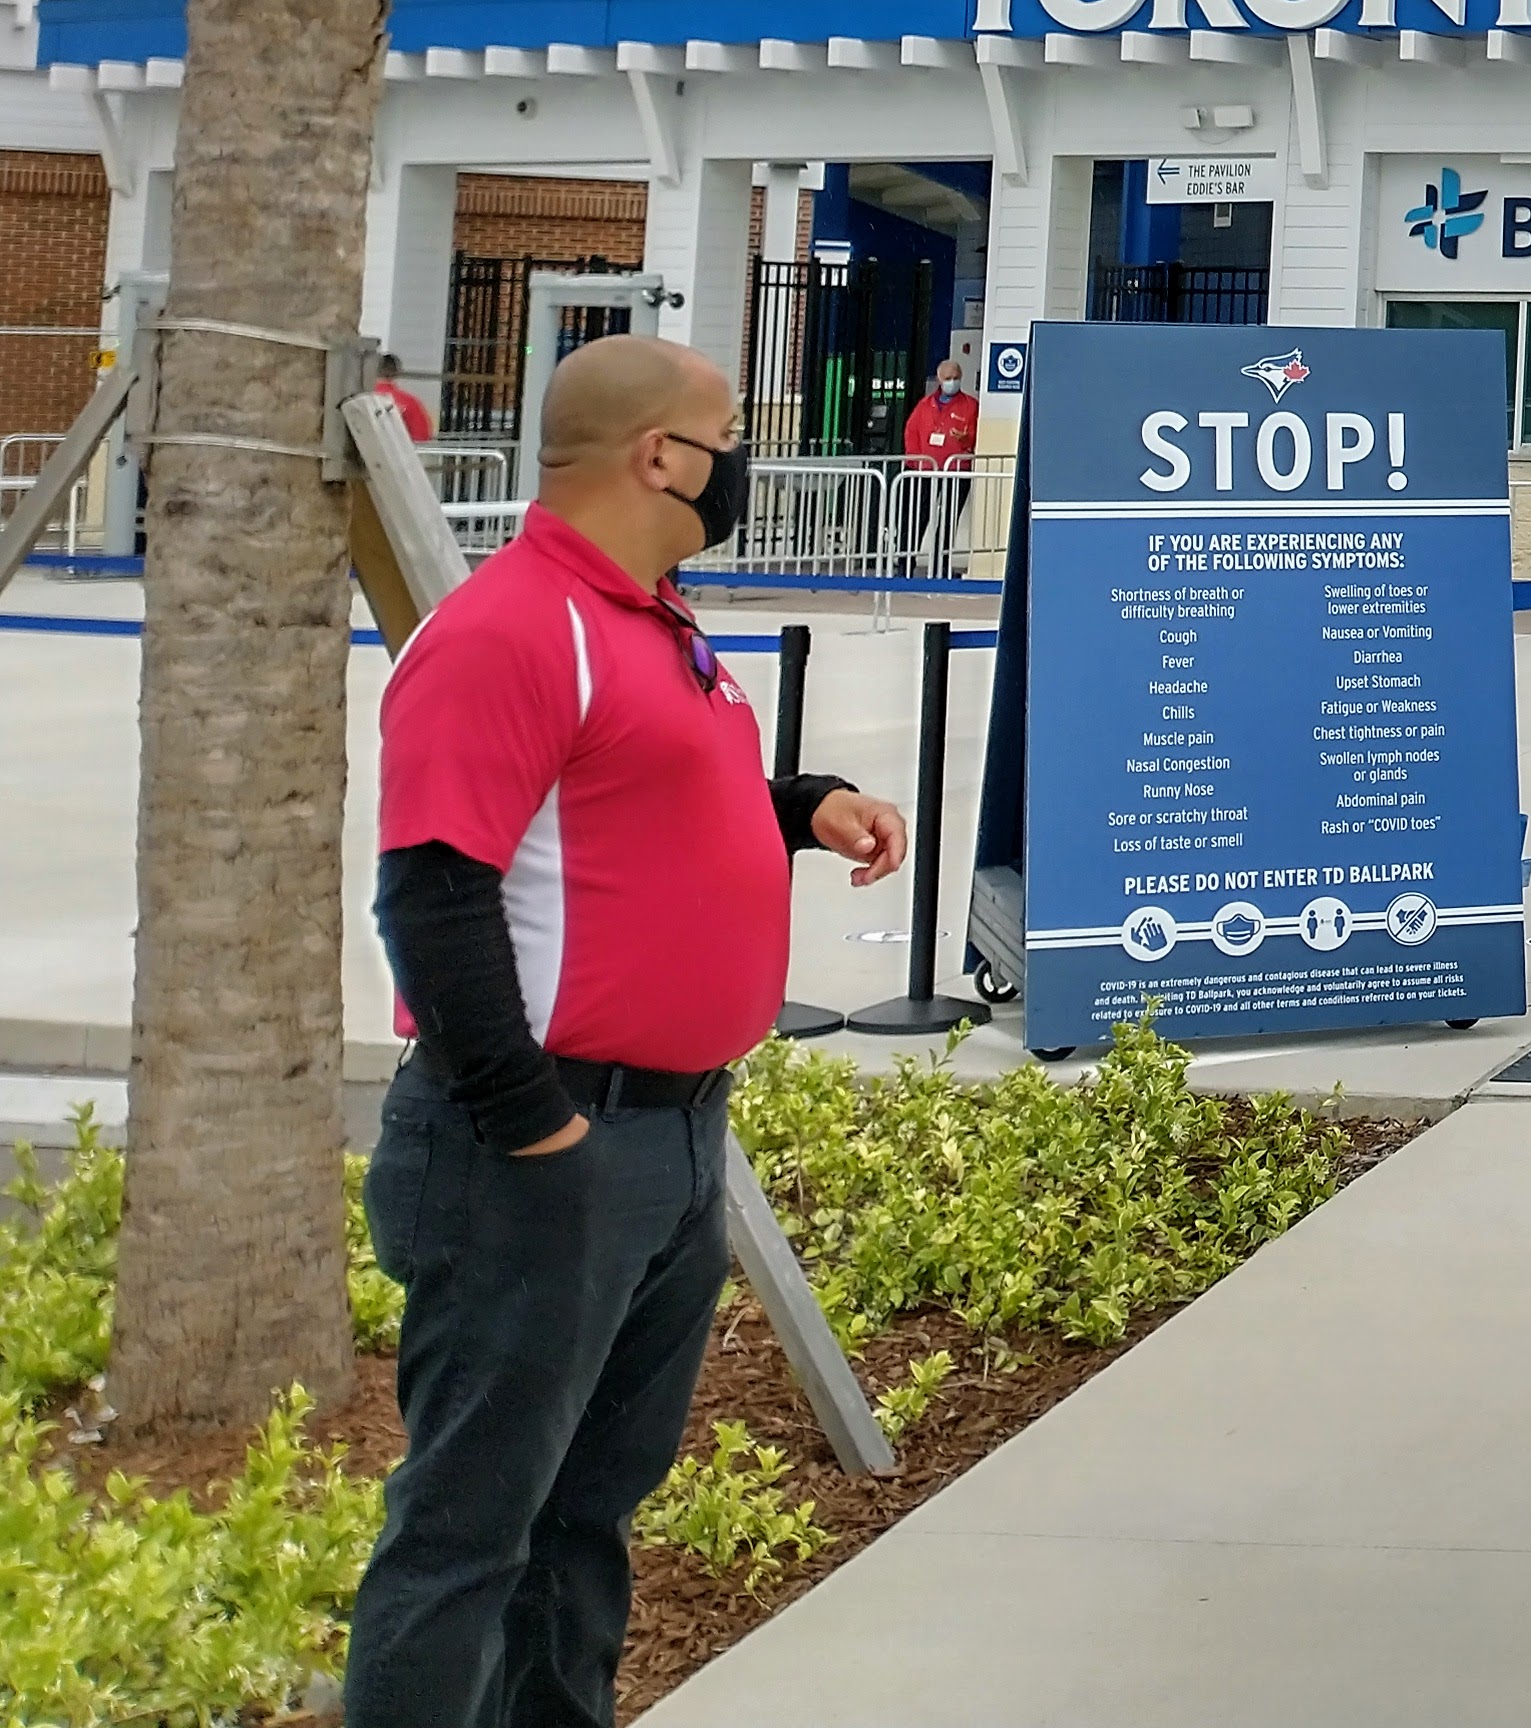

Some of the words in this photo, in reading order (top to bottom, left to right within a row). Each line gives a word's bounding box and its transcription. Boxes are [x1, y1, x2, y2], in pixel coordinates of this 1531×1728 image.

[1188, 165, 1205, 178] THE
[1208, 163, 1251, 177] PAVILION
[1187, 182, 1223, 196] EDDIE'S
[1225, 181, 1244, 195] BAR
[1139, 411, 1407, 491] STOP!
[1149, 535, 1164, 551] IF
[1169, 534, 1203, 551] YOU
[1208, 534, 1241, 550] ARE
[1247, 533, 1365, 550] EXPERIENCING
[1370, 533, 1403, 549] ANY
[1148, 554, 1170, 571] OF
[1174, 553, 1207, 570] THE
[1213, 552, 1306, 570] FOLLOWING
[1312, 552, 1404, 568] SYMPTOMS:
[1111, 588, 1170, 601] Shortness
[1174, 586, 1186, 600] of
[1189, 586, 1228, 600] breath
[1231, 589, 1244, 599] or
[1324, 584, 1370, 600] Swelling
[1374, 583, 1386, 597] of
[1388, 584, 1413, 596] toes
[1416, 586, 1428, 596] or
[1121, 604, 1174, 620] difficulty
[1177, 603, 1234, 619] breathing
[1328, 601, 1359, 614] lower
[1362, 600, 1425, 613] extremities
[1159, 629, 1196, 645] Cough
[1322, 626, 1363, 639] Nausea
[1366, 628, 1379, 638] or
[1382, 624, 1431, 640] Vomiting
[1162, 655, 1194, 668] Fever
[1354, 650, 1402, 663] Diarrhea
[1149, 679, 1207, 694] Headache
[1336, 675, 1368, 690] Upset
[1371, 674, 1420, 688] Stomach
[1162, 705, 1194, 719] Chills
[1321, 700, 1362, 716] Fatigue
[1366, 702, 1378, 713] or
[1381, 699, 1436, 712] Weakness
[1143, 731, 1184, 745] Muscle
[1188, 730, 1213, 747] pain
[1313, 726, 1345, 740] Chest
[1348, 725, 1402, 741] tightness
[1405, 726, 1417, 737] or
[1421, 723, 1444, 739] pain
[1126, 758, 1159, 772] Nasal
[1163, 756, 1229, 773] Congestion
[1320, 751, 1364, 765] Swollen
[1367, 749, 1402, 766] lymph
[1405, 748, 1439, 761] nodes
[1353, 770, 1366, 781] or
[1369, 766, 1407, 783] glands
[1143, 784, 1180, 799] Runny
[1184, 783, 1214, 796] Nose
[1336, 792, 1397, 807] Abdominal
[1401, 791, 1425, 807] pain
[1108, 812, 1135, 825] Sore
[1139, 813, 1152, 824] or
[1156, 808, 1207, 824] scratchy
[1211, 806, 1247, 821] throat
[1321, 820, 1349, 834] Rash
[1352, 822, 1365, 832] or
[1114, 838, 1141, 852] Loss
[1144, 836, 1157, 850] of
[1160, 835, 1190, 849] taste
[1194, 836, 1207, 848] or
[1210, 832, 1242, 847] smell
[1124, 874, 1190, 894] PLEASE
[1195, 873, 1219, 891] DO
[1225, 871, 1258, 889] NOT
[1264, 868, 1317, 887] ENTER
[1322, 867, 1344, 884] TD
[1349, 862, 1433, 883] BALLPARK
